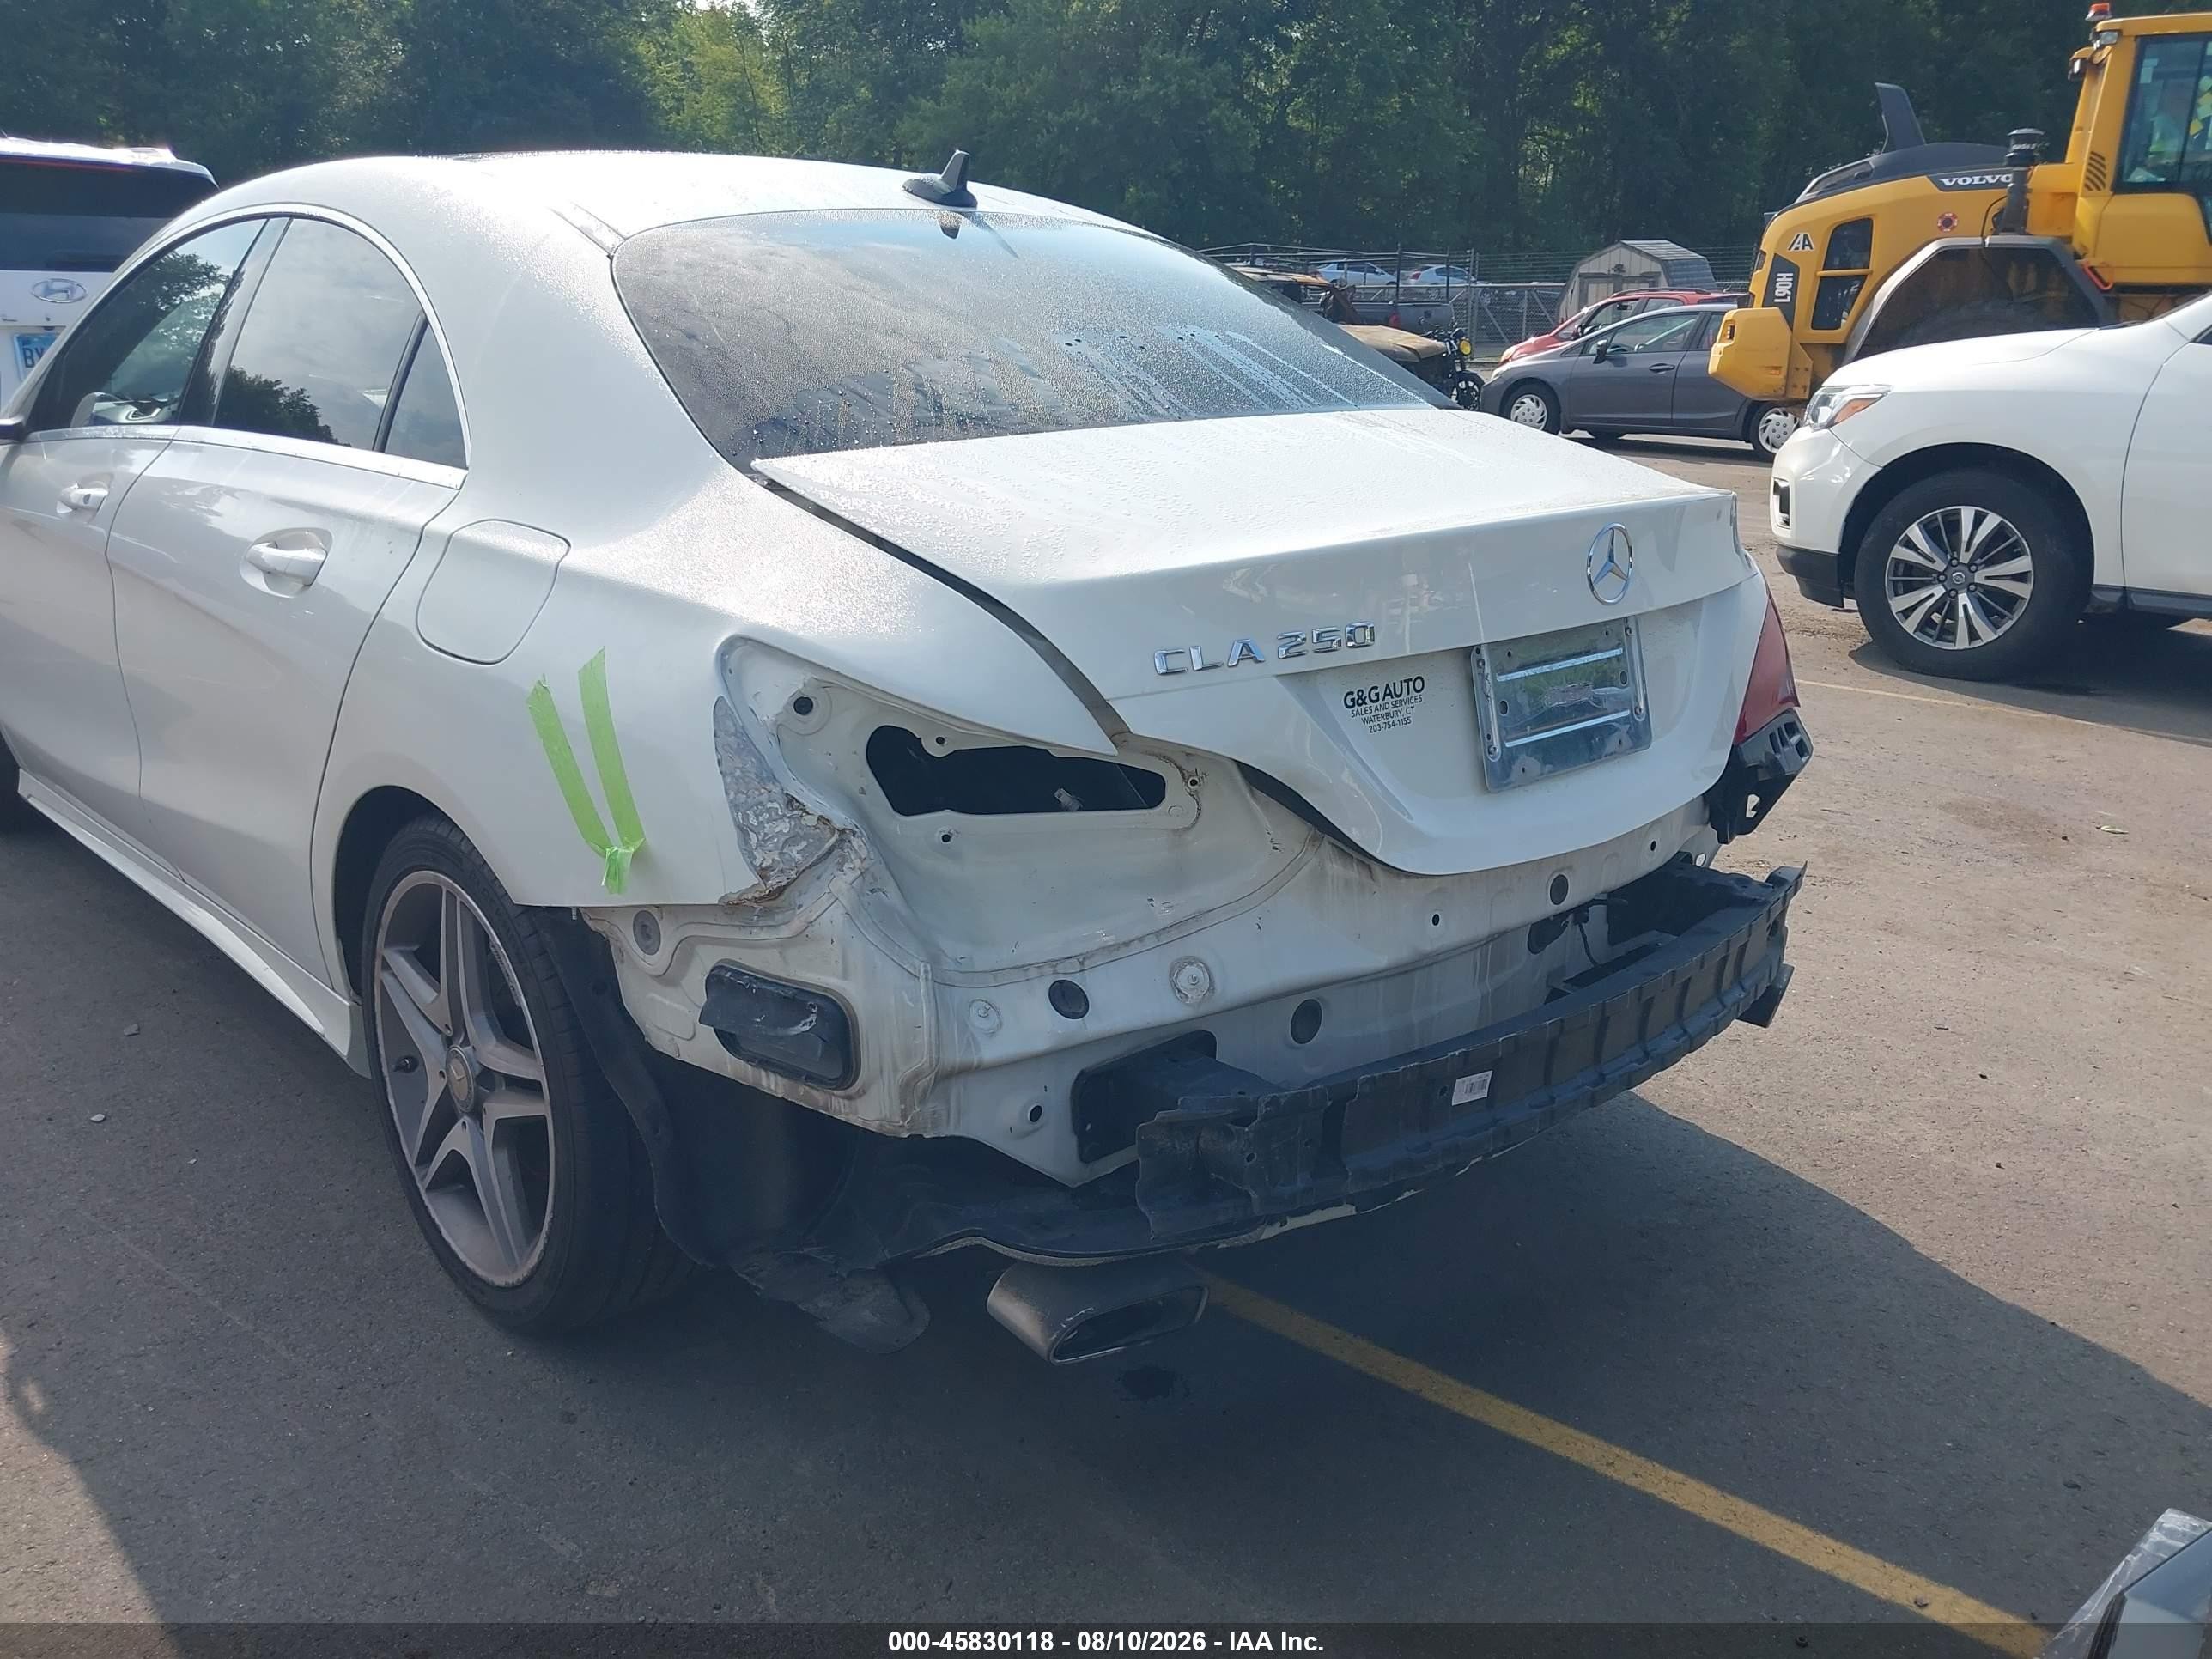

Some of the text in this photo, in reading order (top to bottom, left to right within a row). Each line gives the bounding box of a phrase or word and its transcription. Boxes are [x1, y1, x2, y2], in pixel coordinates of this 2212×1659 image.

[1940, 173, 2014, 186] VOLVO
[1773, 272, 1794, 303] L90H
[1153, 620, 1375, 675] CLA 250
[1343, 676, 1425, 709] G&G AUTO
[1351, 694, 1423, 718] SALES AND SERVICES
[1361, 706, 1415, 726] WATERBURY, CT
[1369, 716, 1412, 733] 203-754-1155
